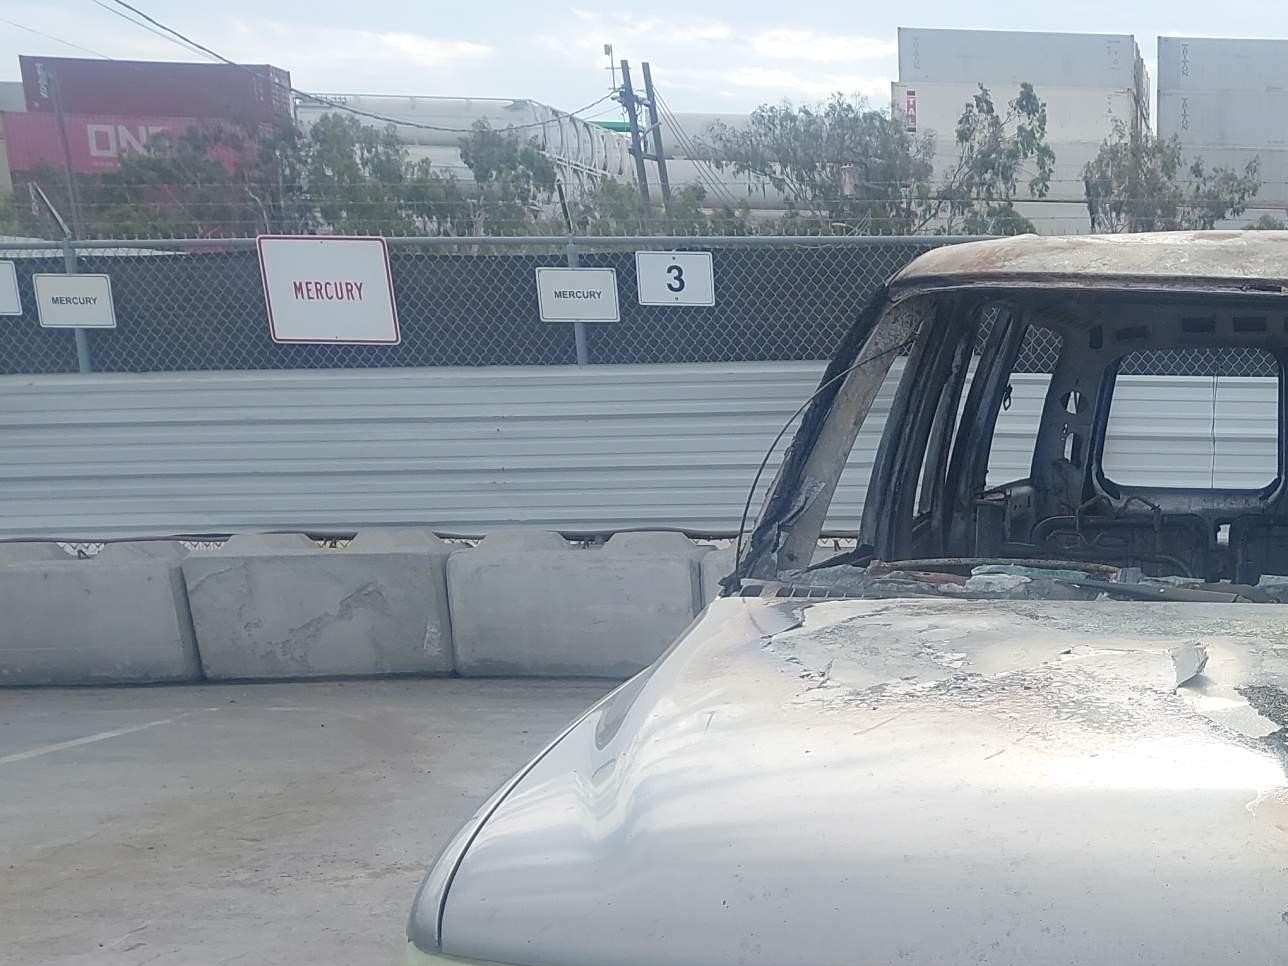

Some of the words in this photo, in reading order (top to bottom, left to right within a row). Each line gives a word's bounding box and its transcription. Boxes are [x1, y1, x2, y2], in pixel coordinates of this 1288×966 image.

[87, 124, 168, 158] ON
[666, 264, 686, 293] 3
[51, 296, 97, 305] MERCURY
[293, 281, 364, 301] MERCURY
[554, 290, 602, 299] MERCURY
